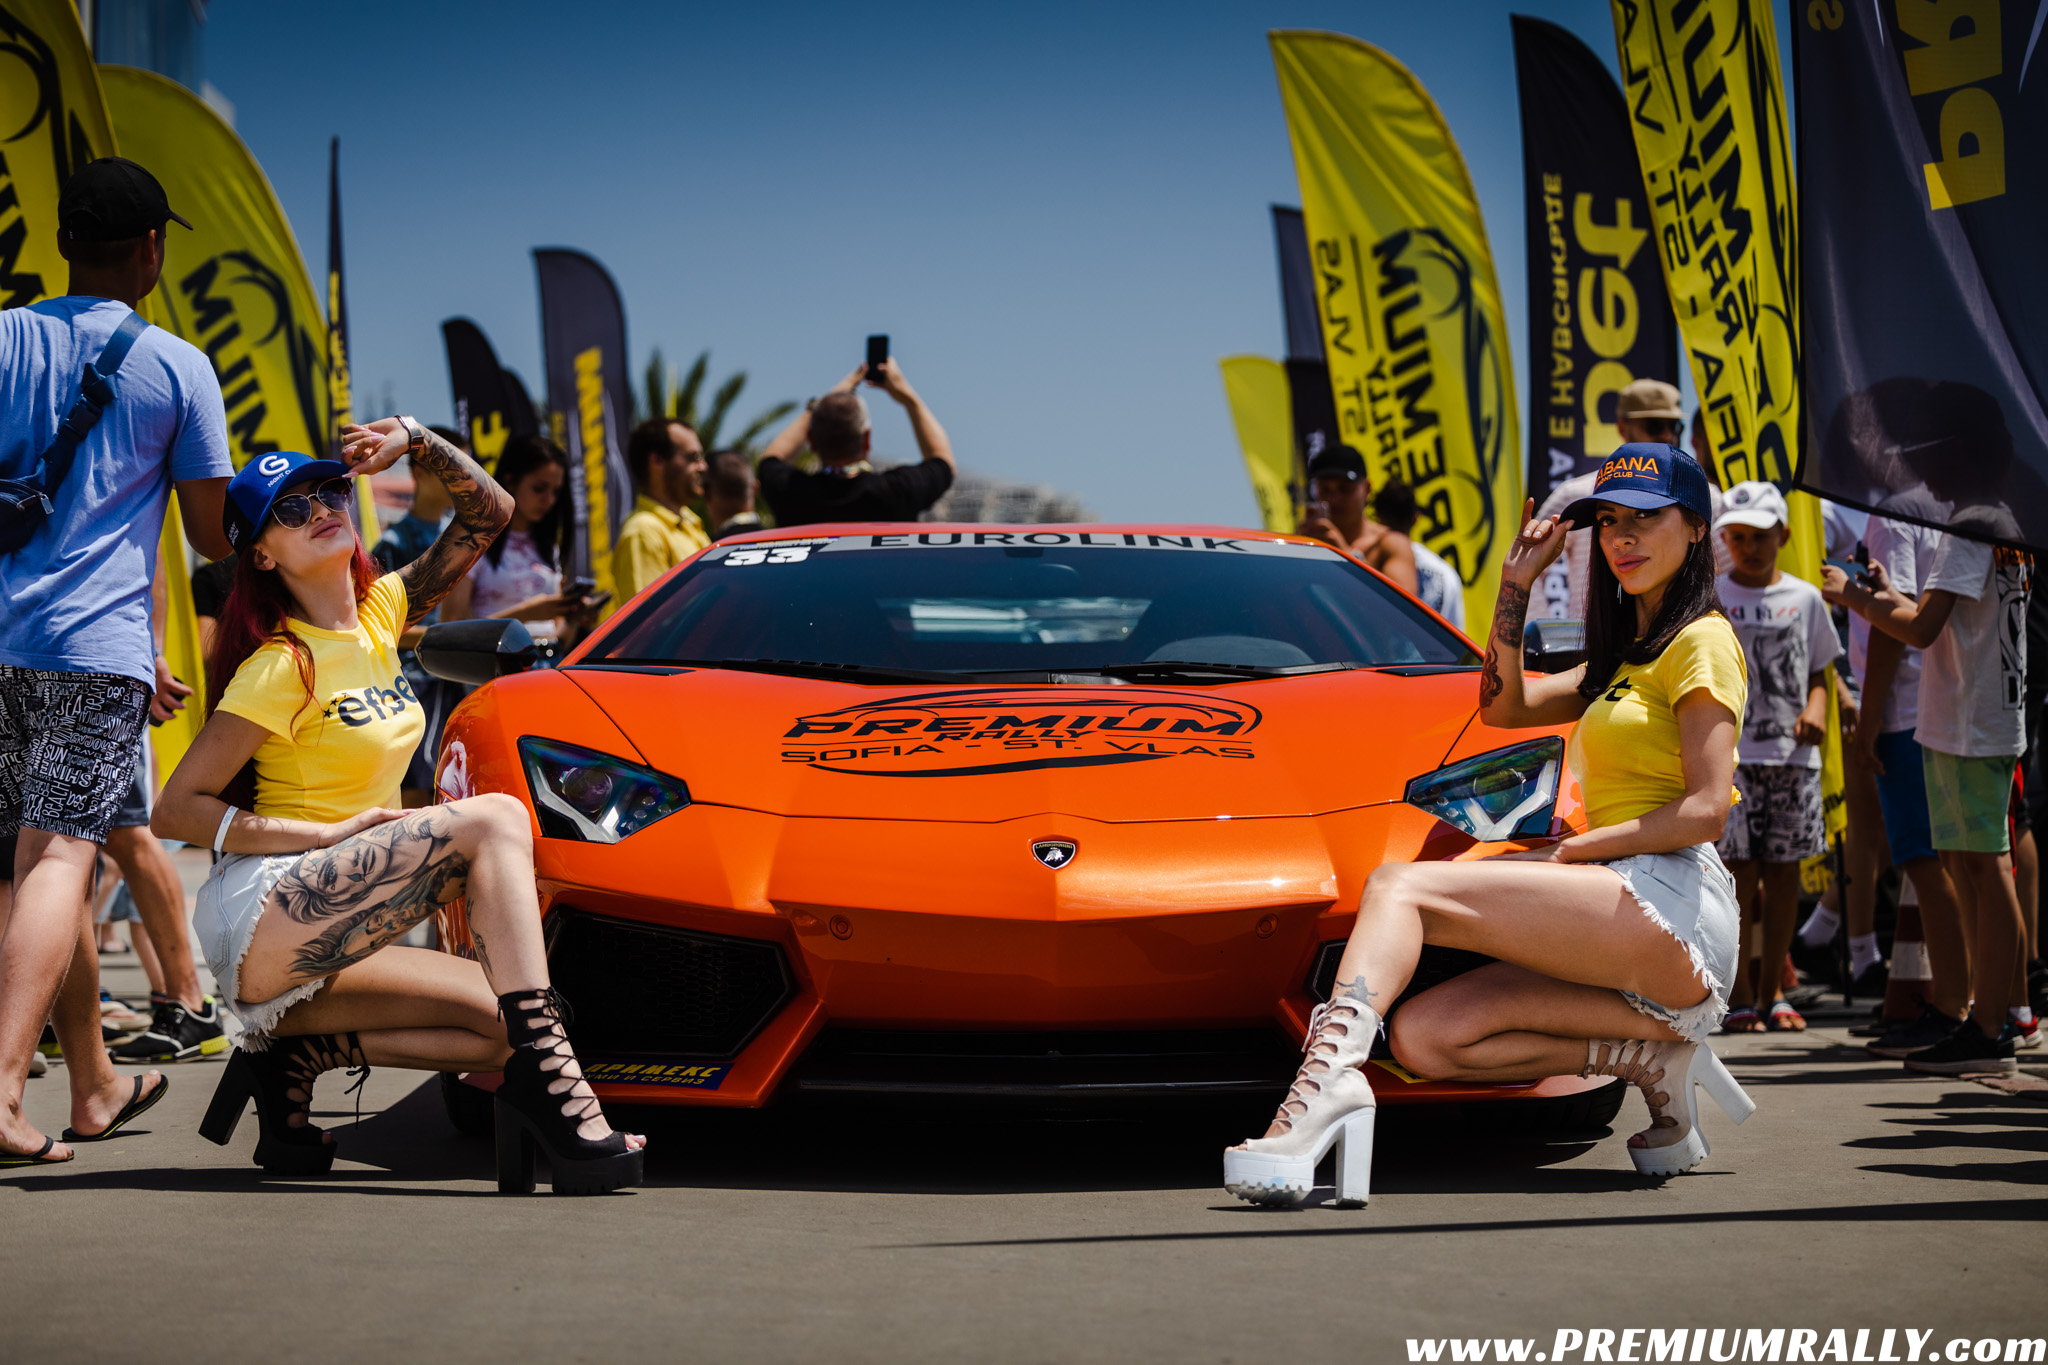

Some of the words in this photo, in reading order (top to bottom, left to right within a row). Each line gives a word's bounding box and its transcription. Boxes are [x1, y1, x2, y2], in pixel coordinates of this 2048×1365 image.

[258, 455, 290, 477] G
[1596, 456, 1660, 482] ABANA
[1613, 471, 1633, 479] CLUB
[871, 532, 1247, 552] EUROLINK
[724, 546, 812, 567] 33
[338, 675, 418, 727] efbe
[783, 715, 1246, 737] PREMIUM
[933, 729, 1098, 742] RALLY
[44, 744, 69, 763] SUN
[781, 744, 944, 762] SOFIA
[1003, 738, 1082, 750] ST.
[1104, 741, 1255, 759] VLAS
[583, 1063, 722, 1078] ПРИМЕКС
[584, 1073, 620, 1081] УМИ
[640, 1075, 705, 1085] СЕРВИЗ
